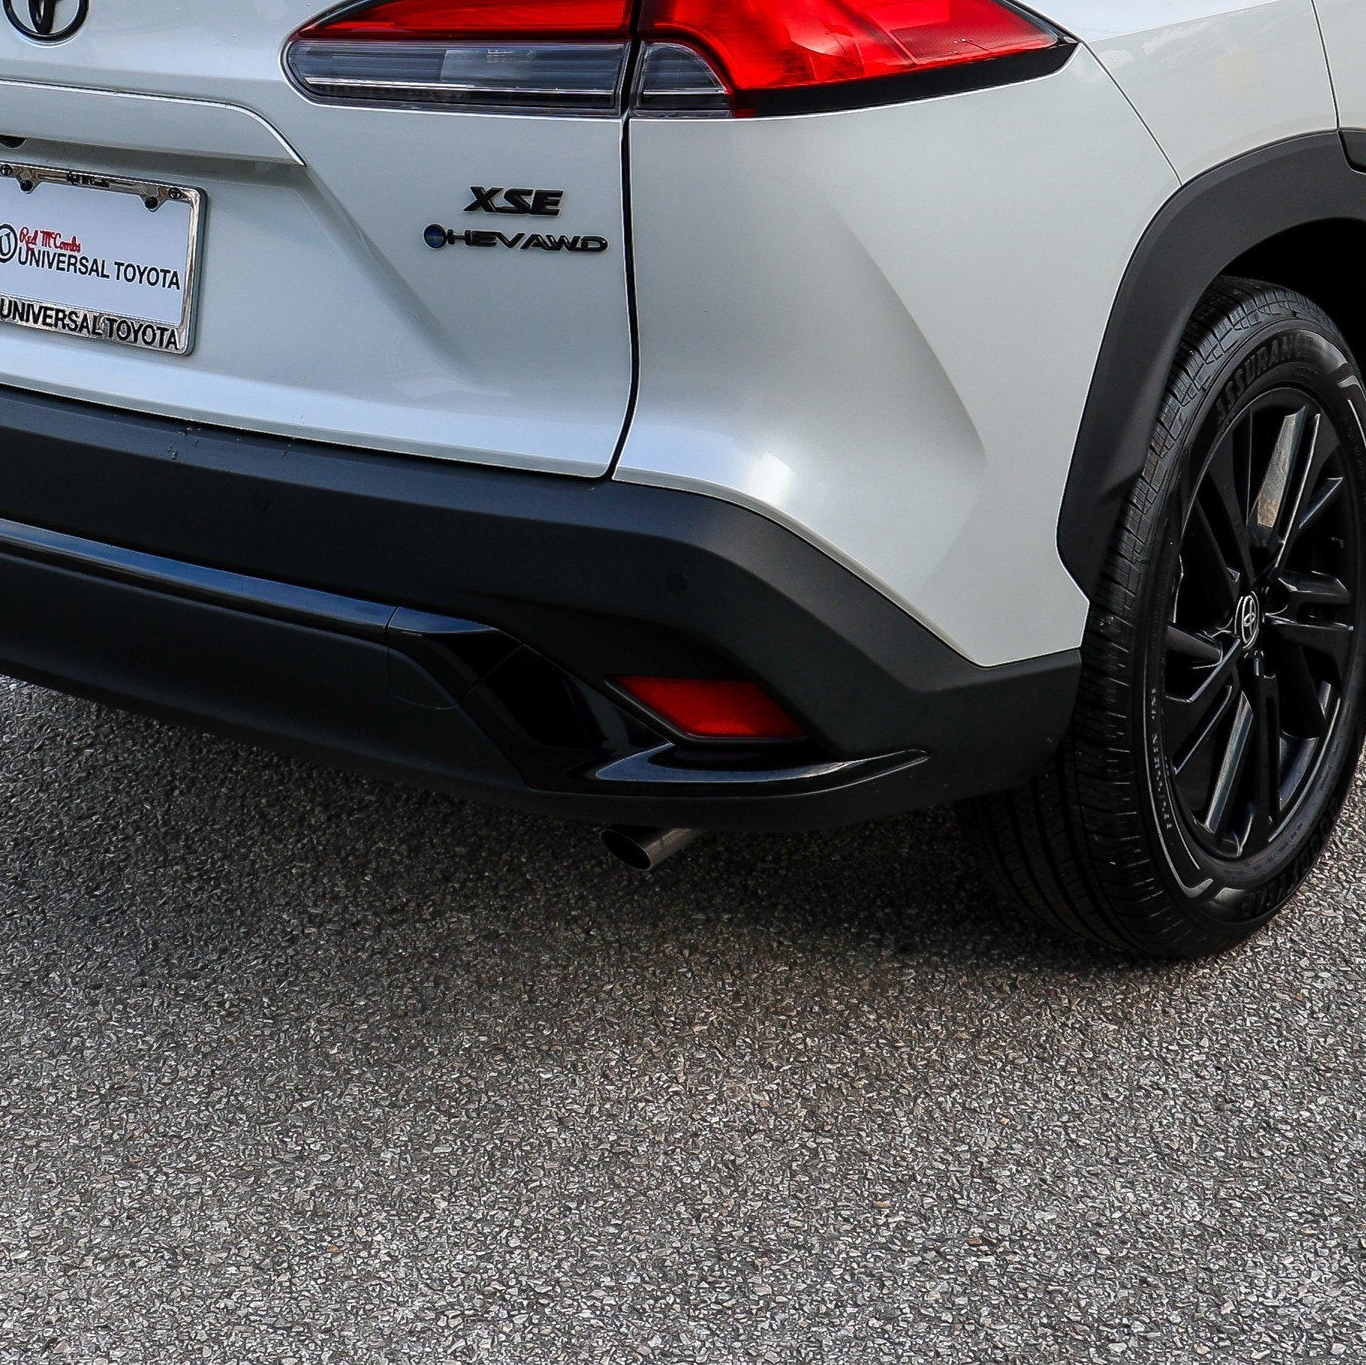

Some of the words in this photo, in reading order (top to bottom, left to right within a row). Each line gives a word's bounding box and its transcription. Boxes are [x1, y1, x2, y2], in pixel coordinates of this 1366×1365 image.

[463, 186, 565, 216] XSE
[19, 226, 39, 252] Red
[18, 246, 110, 279] UNIVERSAL
[114, 262, 181, 290] TOYOTA
[0, 299, 103, 335] UNIVERSAL
[105, 318, 179, 350] TOYOTA
